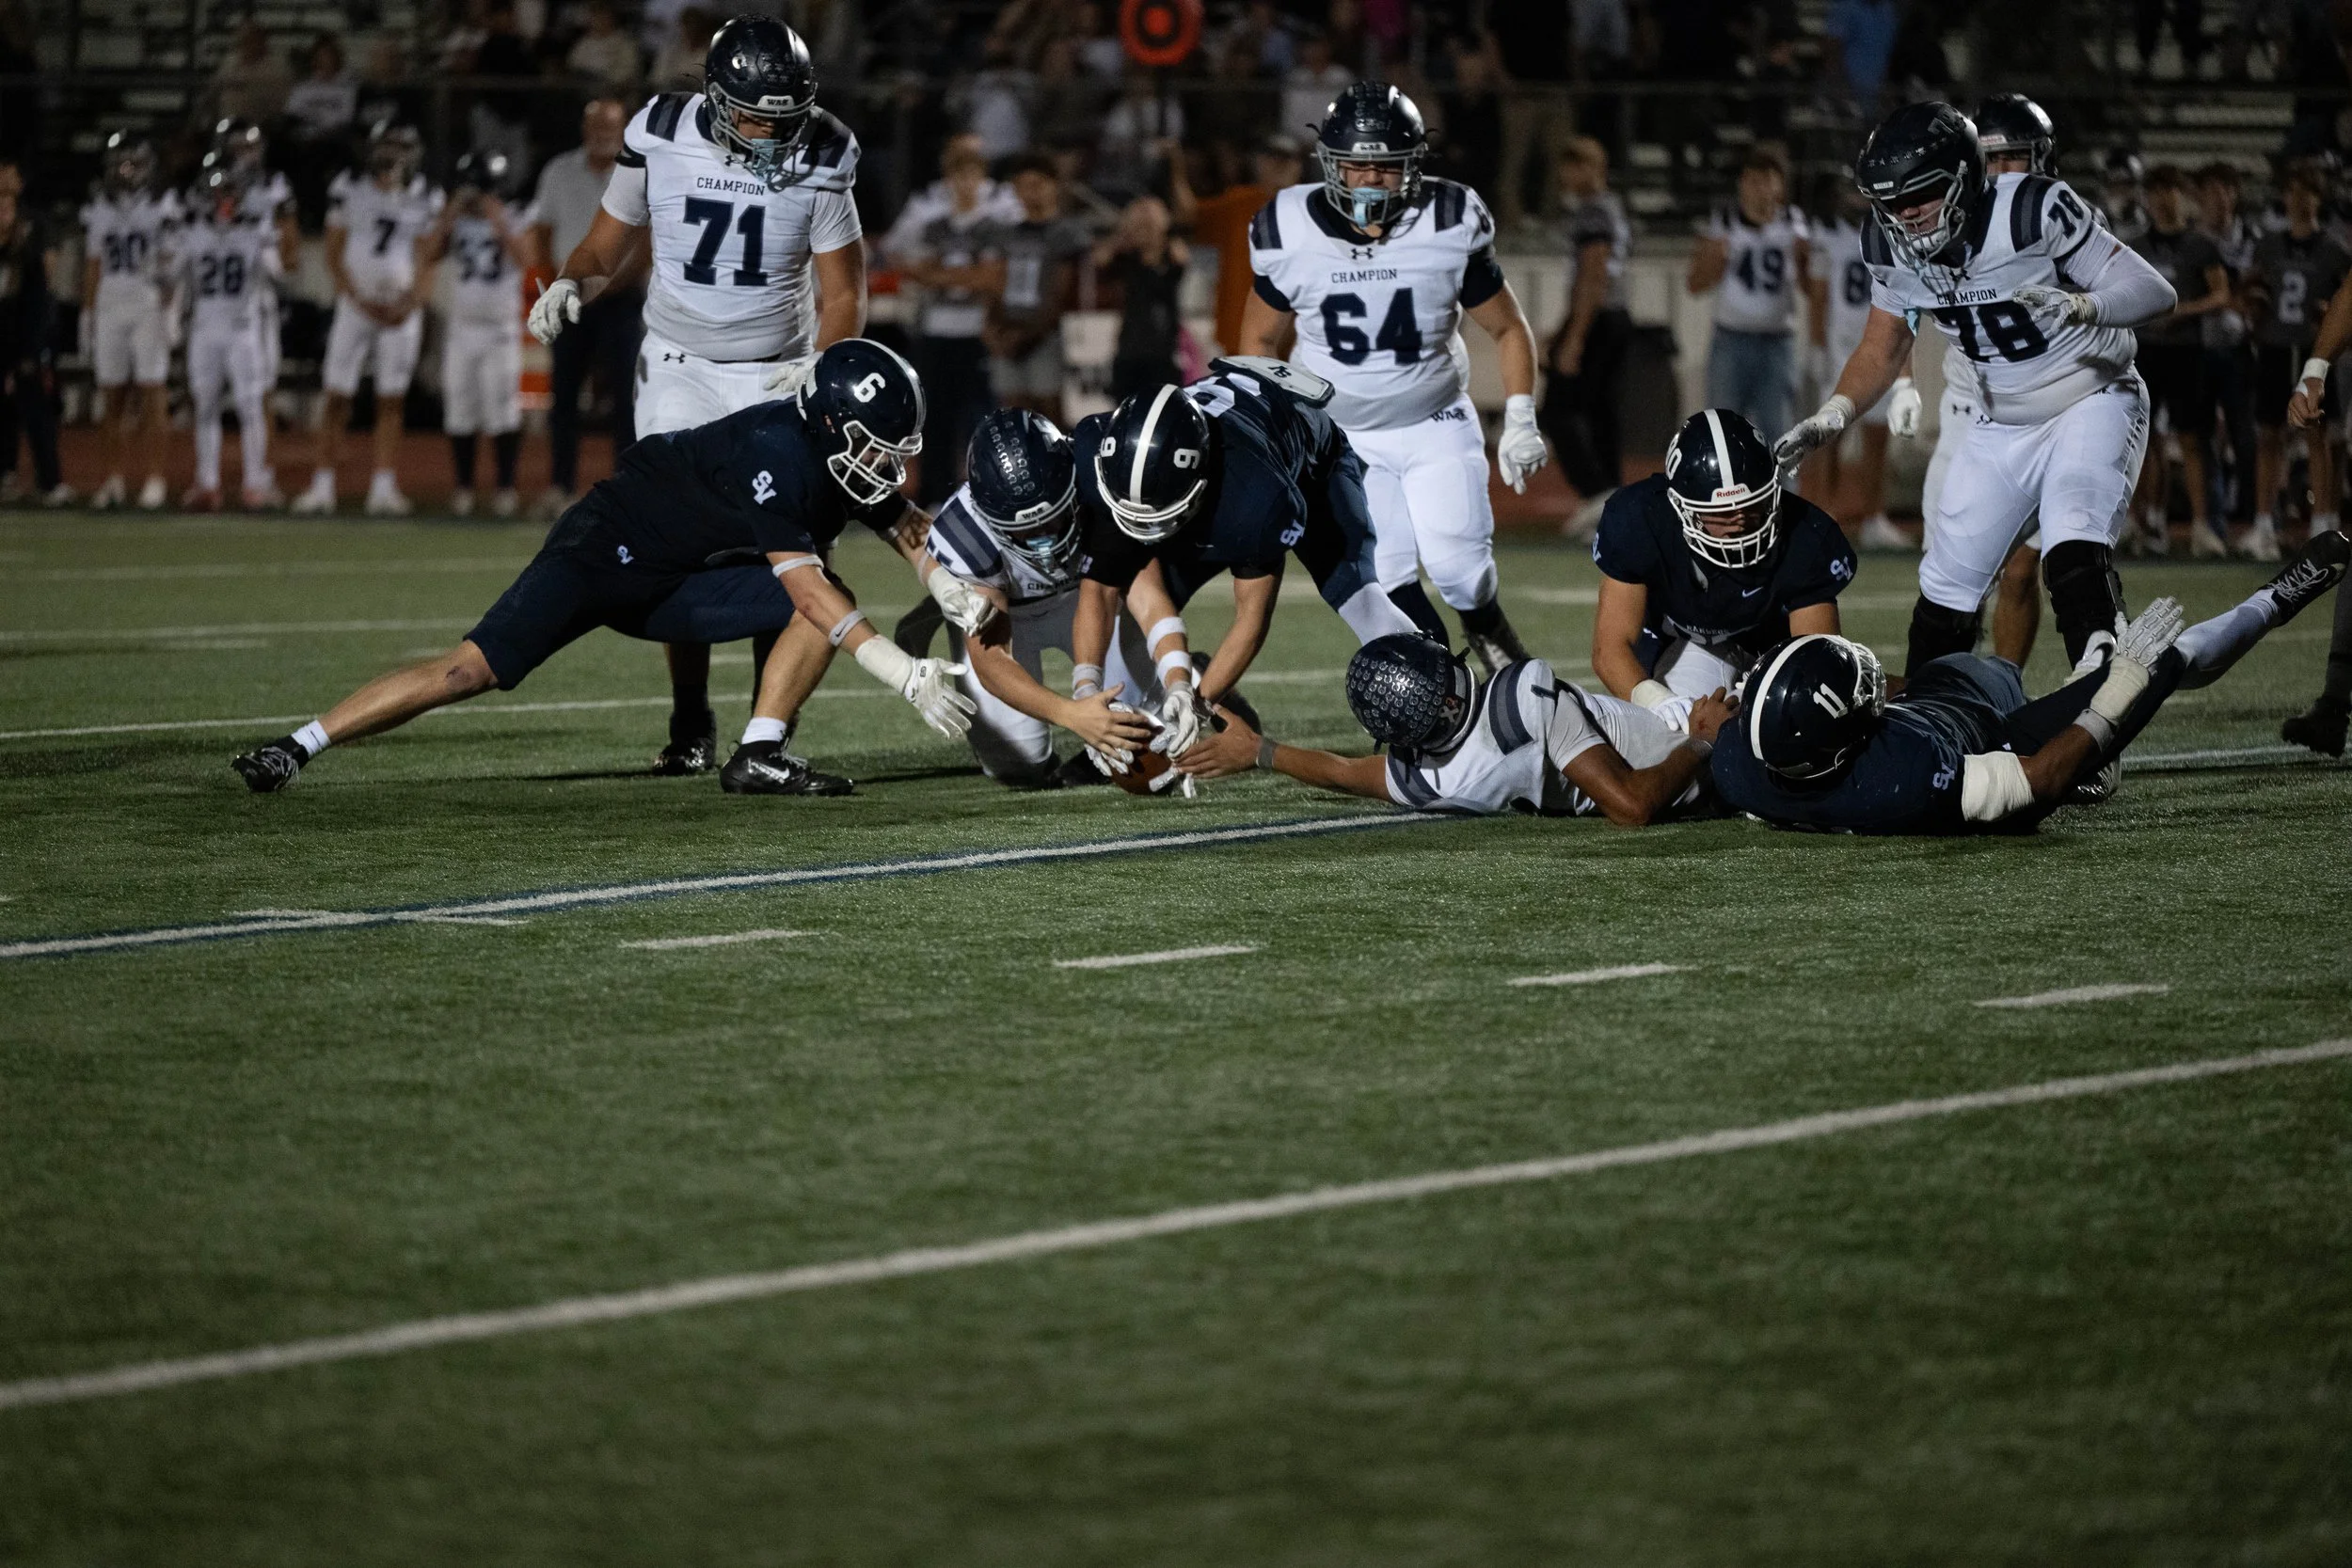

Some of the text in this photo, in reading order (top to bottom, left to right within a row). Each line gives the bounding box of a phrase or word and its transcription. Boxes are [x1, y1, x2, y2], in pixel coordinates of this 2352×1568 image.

[697, 178, 766, 196] CHAMPION
[377, 219, 395, 252] 7
[683, 196, 768, 286] 71
[1331, 268, 1398, 284] CHAMPION
[1937, 289, 1997, 306] CHAMPION
[1320, 287, 1422, 366] 64
[1716, 486, 1746, 499] Riddell
[1812, 683, 1849, 719] 11
